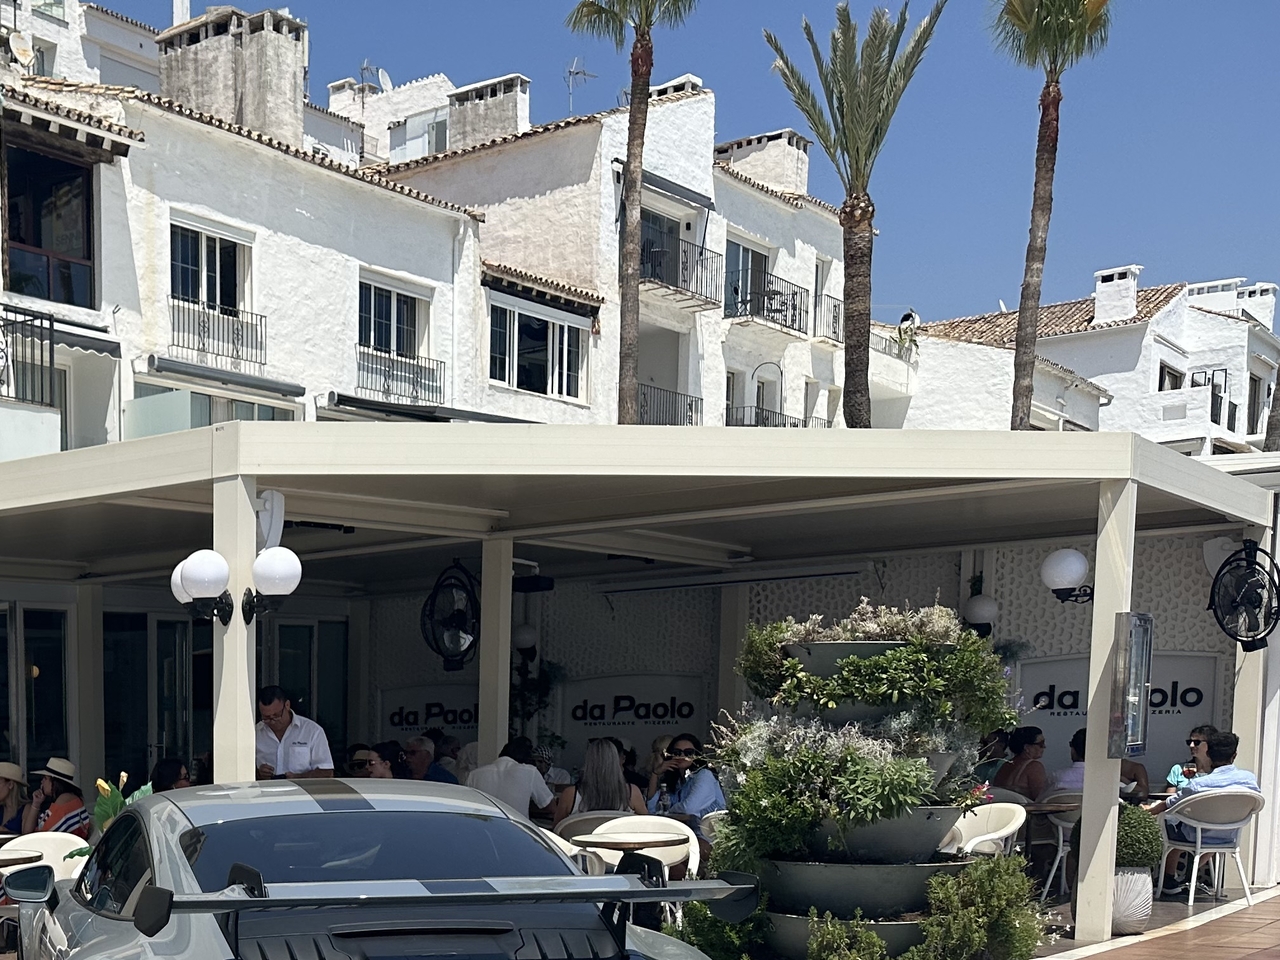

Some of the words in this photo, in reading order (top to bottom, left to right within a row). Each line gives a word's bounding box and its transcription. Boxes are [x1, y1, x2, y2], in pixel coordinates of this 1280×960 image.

[571, 698, 606, 721] da
[612, 695, 695, 720] Paolo
[1033, 684, 1080, 710] da
[389, 705, 419, 727] da
[424, 702, 479, 725] Paol
